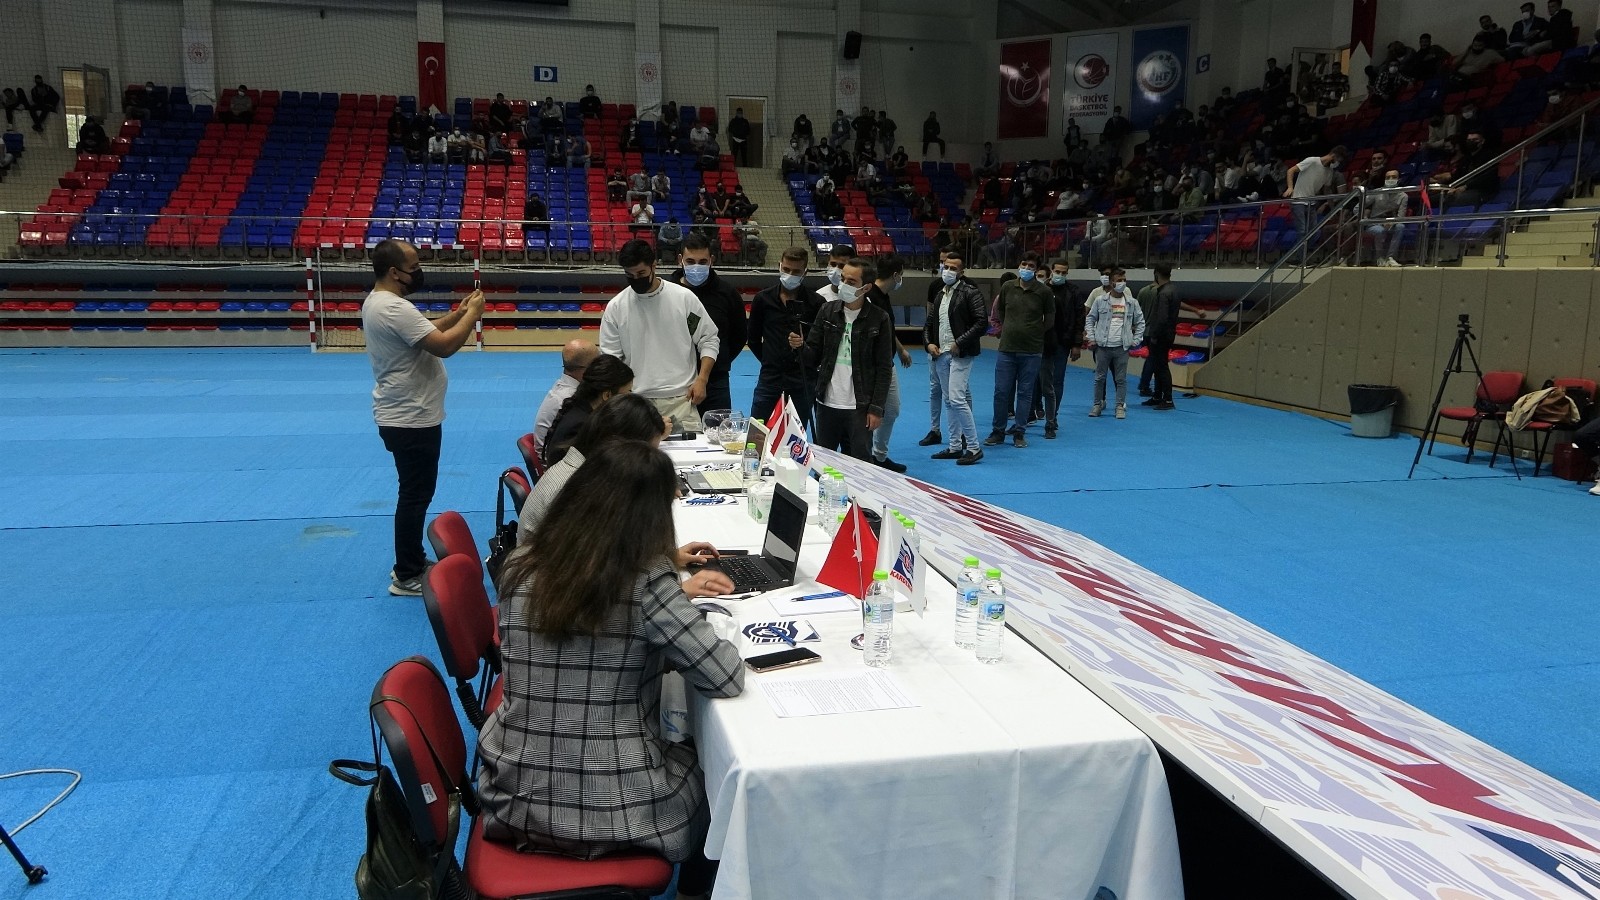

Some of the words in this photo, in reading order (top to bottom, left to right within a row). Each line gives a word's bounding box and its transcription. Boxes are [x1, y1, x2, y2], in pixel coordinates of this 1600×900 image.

[1199, 56, 1208, 72] C
[539, 67, 554, 81] D
[1070, 93, 1109, 104] TÜRKİYE
[1070, 103, 1108, 111] BASKETBOL
